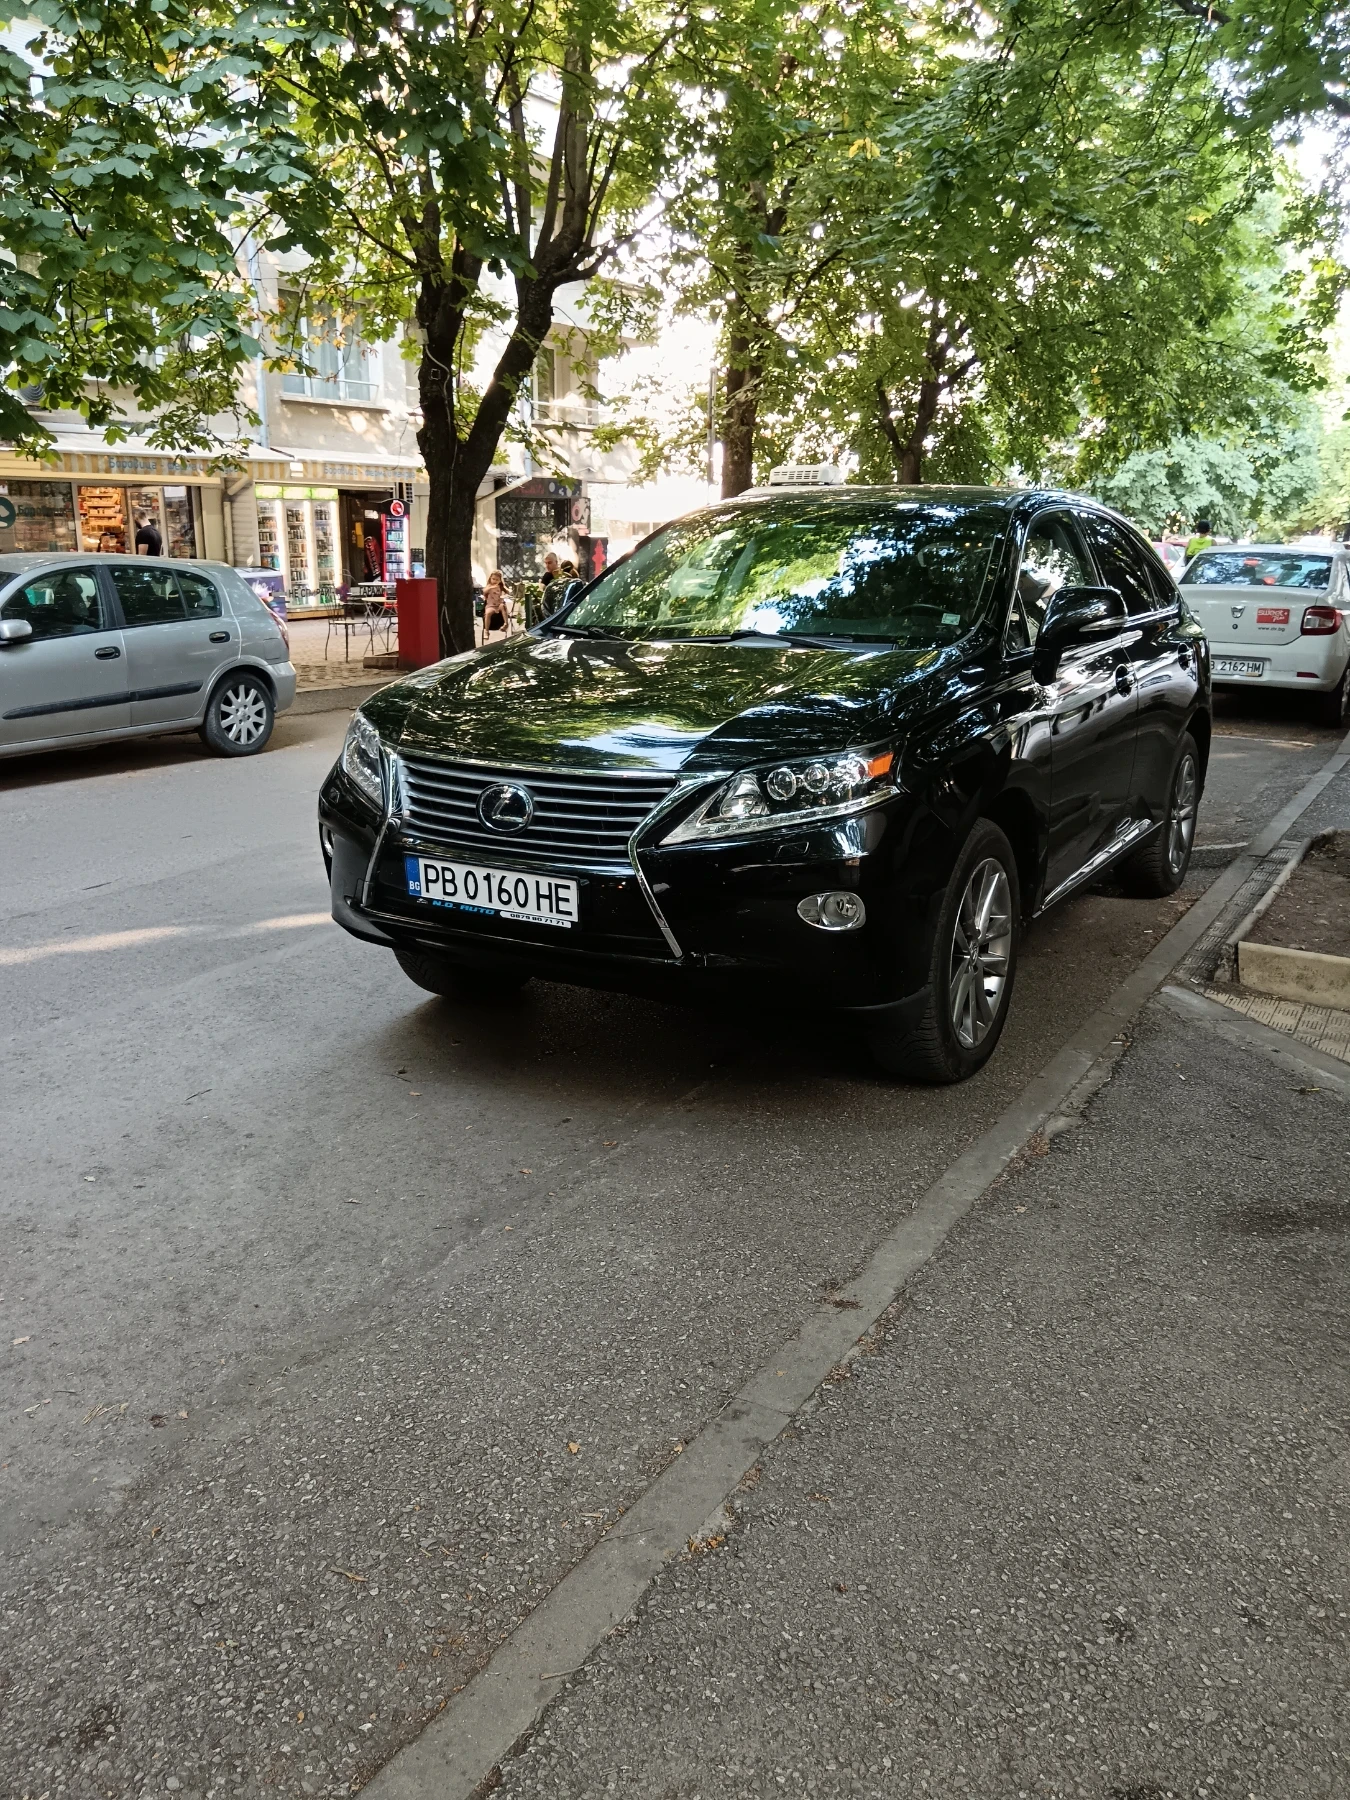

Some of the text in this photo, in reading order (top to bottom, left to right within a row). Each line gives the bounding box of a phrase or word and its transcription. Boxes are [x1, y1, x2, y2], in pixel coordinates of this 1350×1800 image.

[288, 589, 298, 598] НЕ
[1220, 661, 1246, 671] 2162
[1246, 662, 1262, 673] HM
[409, 880, 421, 891] BG
[423, 863, 573, 916] PB 0160 HE
[460, 904, 495, 915] AUTO
